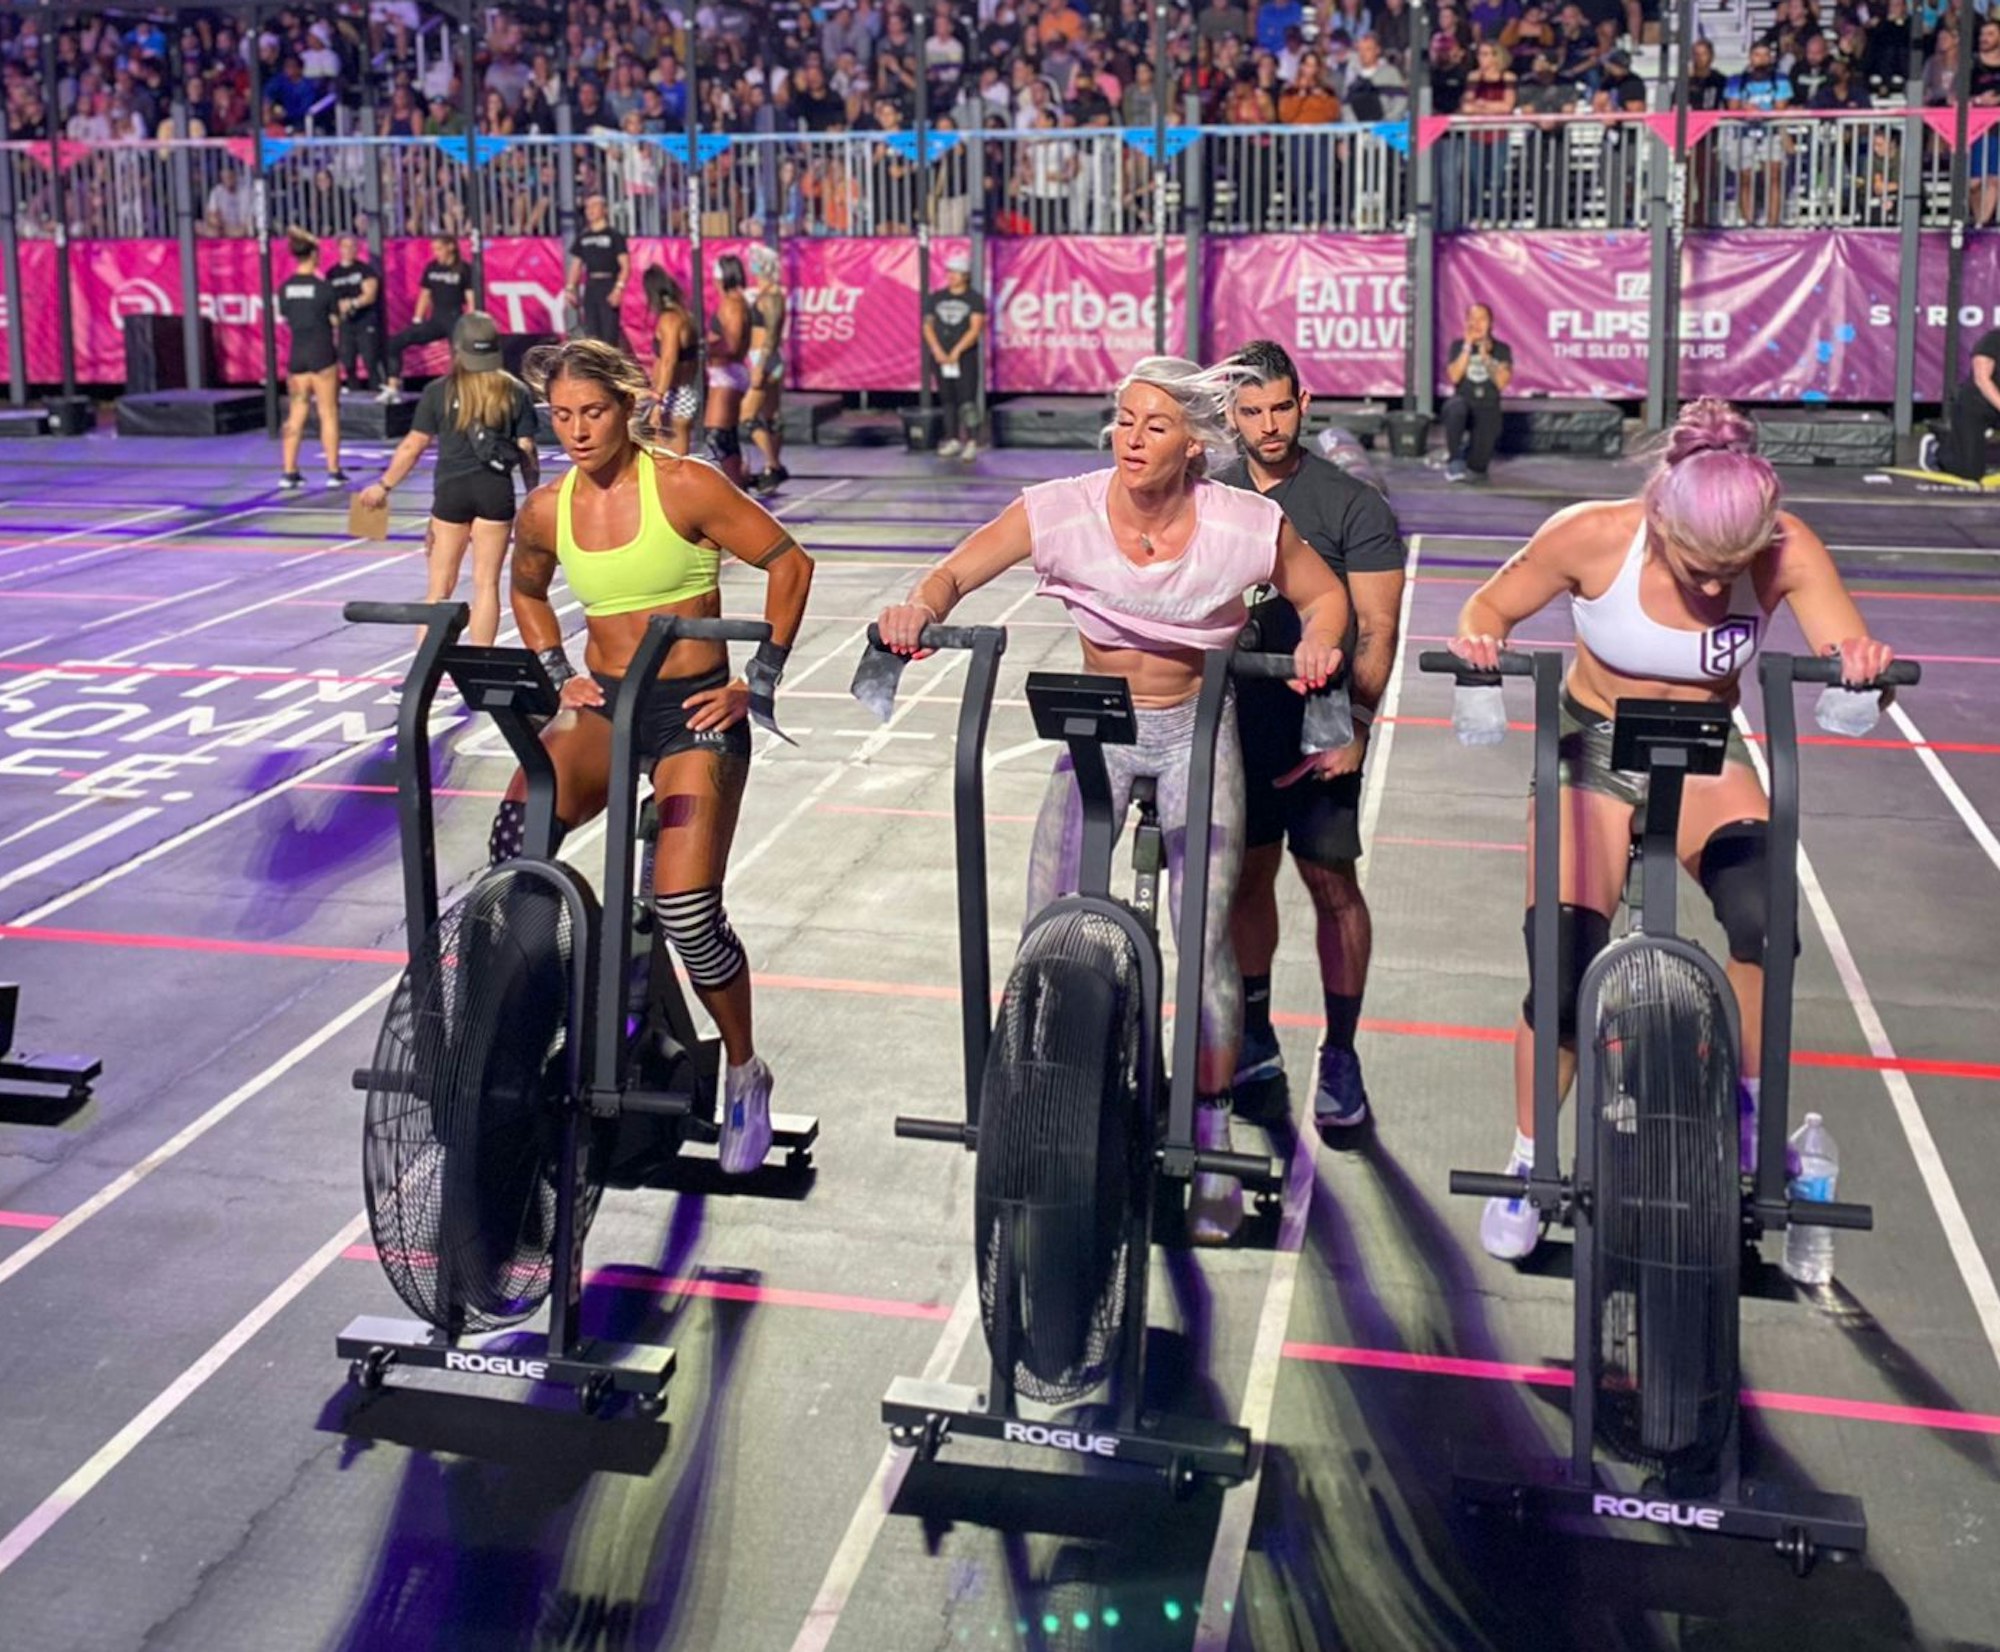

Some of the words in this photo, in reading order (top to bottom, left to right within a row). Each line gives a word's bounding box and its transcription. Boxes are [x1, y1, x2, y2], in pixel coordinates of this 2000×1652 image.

[488, 281, 567, 334] TY
[1297, 275, 1361, 313] EAT
[1547, 310, 1731, 340] FLIPSED
[1869, 304, 2000, 327] SRO
[1552, 343, 1583, 359] THE
[1587, 343, 1630, 359] SLED
[446, 1351, 548, 1380] ROGUE
[1004, 1421, 1120, 1457] ROGUE
[1592, 1493, 1724, 1530] ROGUE
